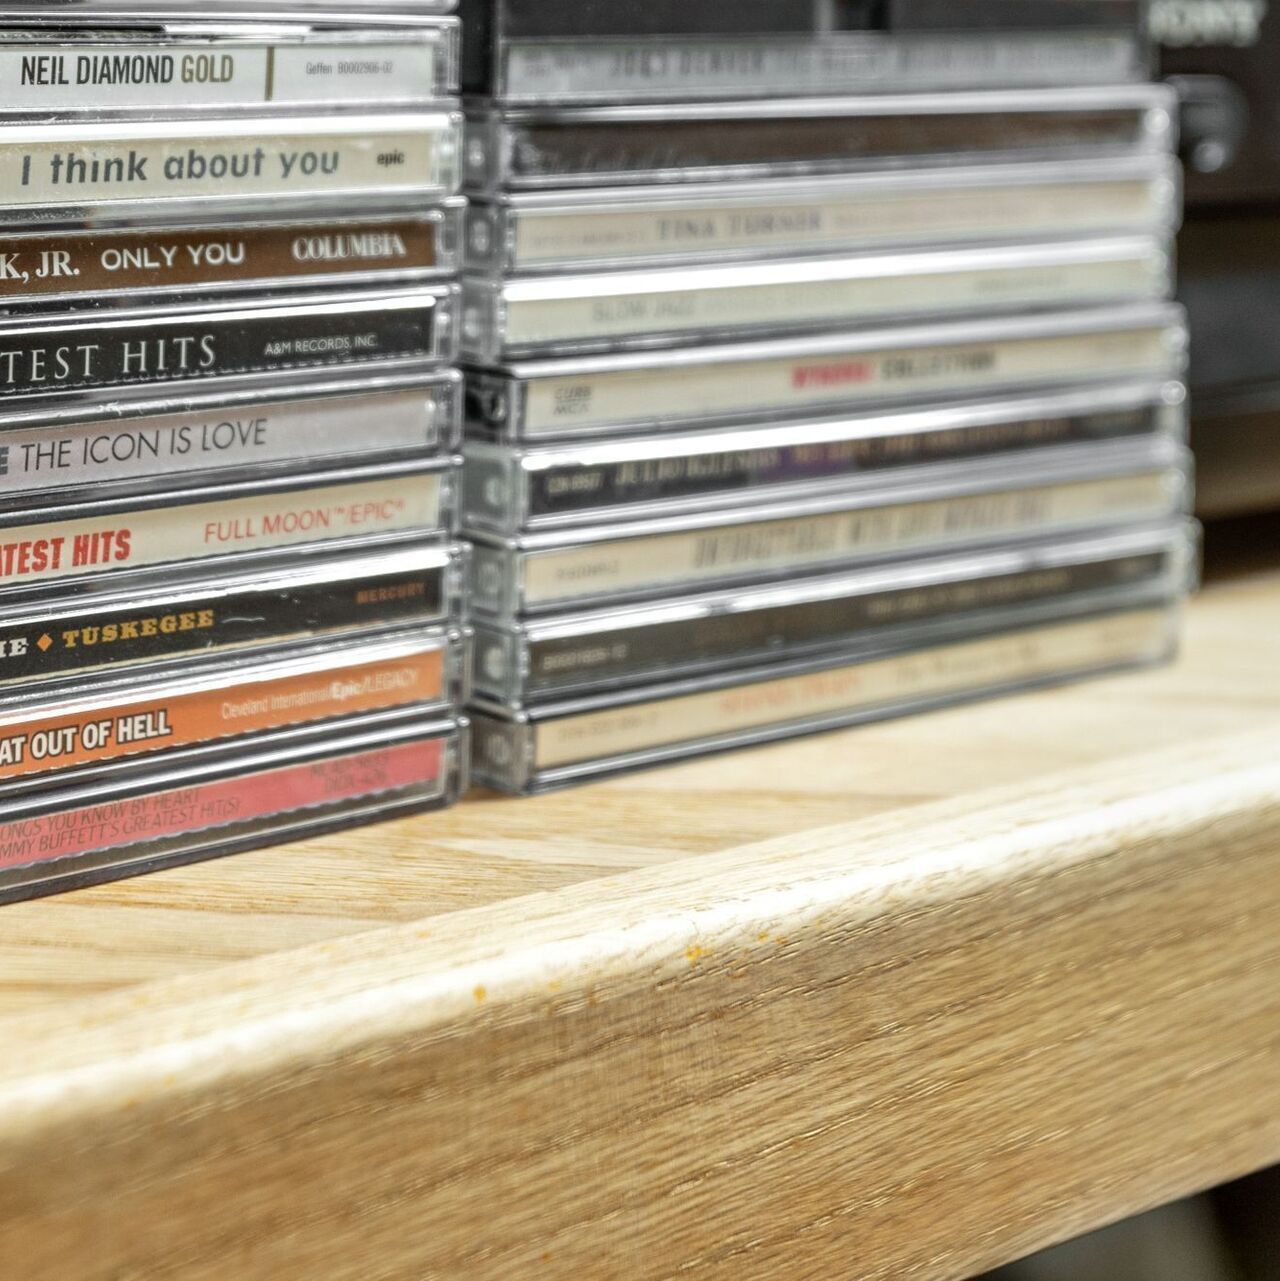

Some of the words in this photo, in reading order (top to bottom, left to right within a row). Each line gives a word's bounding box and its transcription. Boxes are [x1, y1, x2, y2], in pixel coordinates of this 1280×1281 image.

[20, 55, 70, 86] NEIL
[76, 55, 174, 85] DIAMOND
[181, 55, 234, 83] GOLD
[306, 62, 333, 75] Geffen
[22, 155, 31, 186] I
[51, 150, 148, 185] think
[164, 147, 266, 181] about
[279, 149, 340, 178] you
[376, 150, 405, 168] epic
[36, 249, 80, 278] JR.
[101, 240, 179, 271] ONLY
[187, 242, 245, 266] YOU
[292, 232, 407, 263] COLUMBIA
[121, 335, 216, 374] HITS
[264, 341, 292, 356] A&M
[21, 438, 72, 472] THE
[83, 431, 160, 465] ICON
[171, 426, 191, 455] IS
[202, 418, 268, 452] LOVE
[71, 528, 131, 567] HITS
[204, 520, 256, 544] FULL
[357, 581, 426, 606] MERCURY
[62, 609, 215, 650] TUSKEGEE
[222, 696, 268, 719] Cleveland
[31, 729, 75, 760] OUT
[82, 722, 112, 750] OF
[118, 710, 173, 745] HELL
[38, 822, 120, 852] BUFFETT'S
[122, 805, 195, 835] GREATEST
[46, 812, 78, 832] YOU
[81, 803, 128, 828] KNOW
[129, 796, 150, 816] BY
[153, 789, 200, 812] HEART
